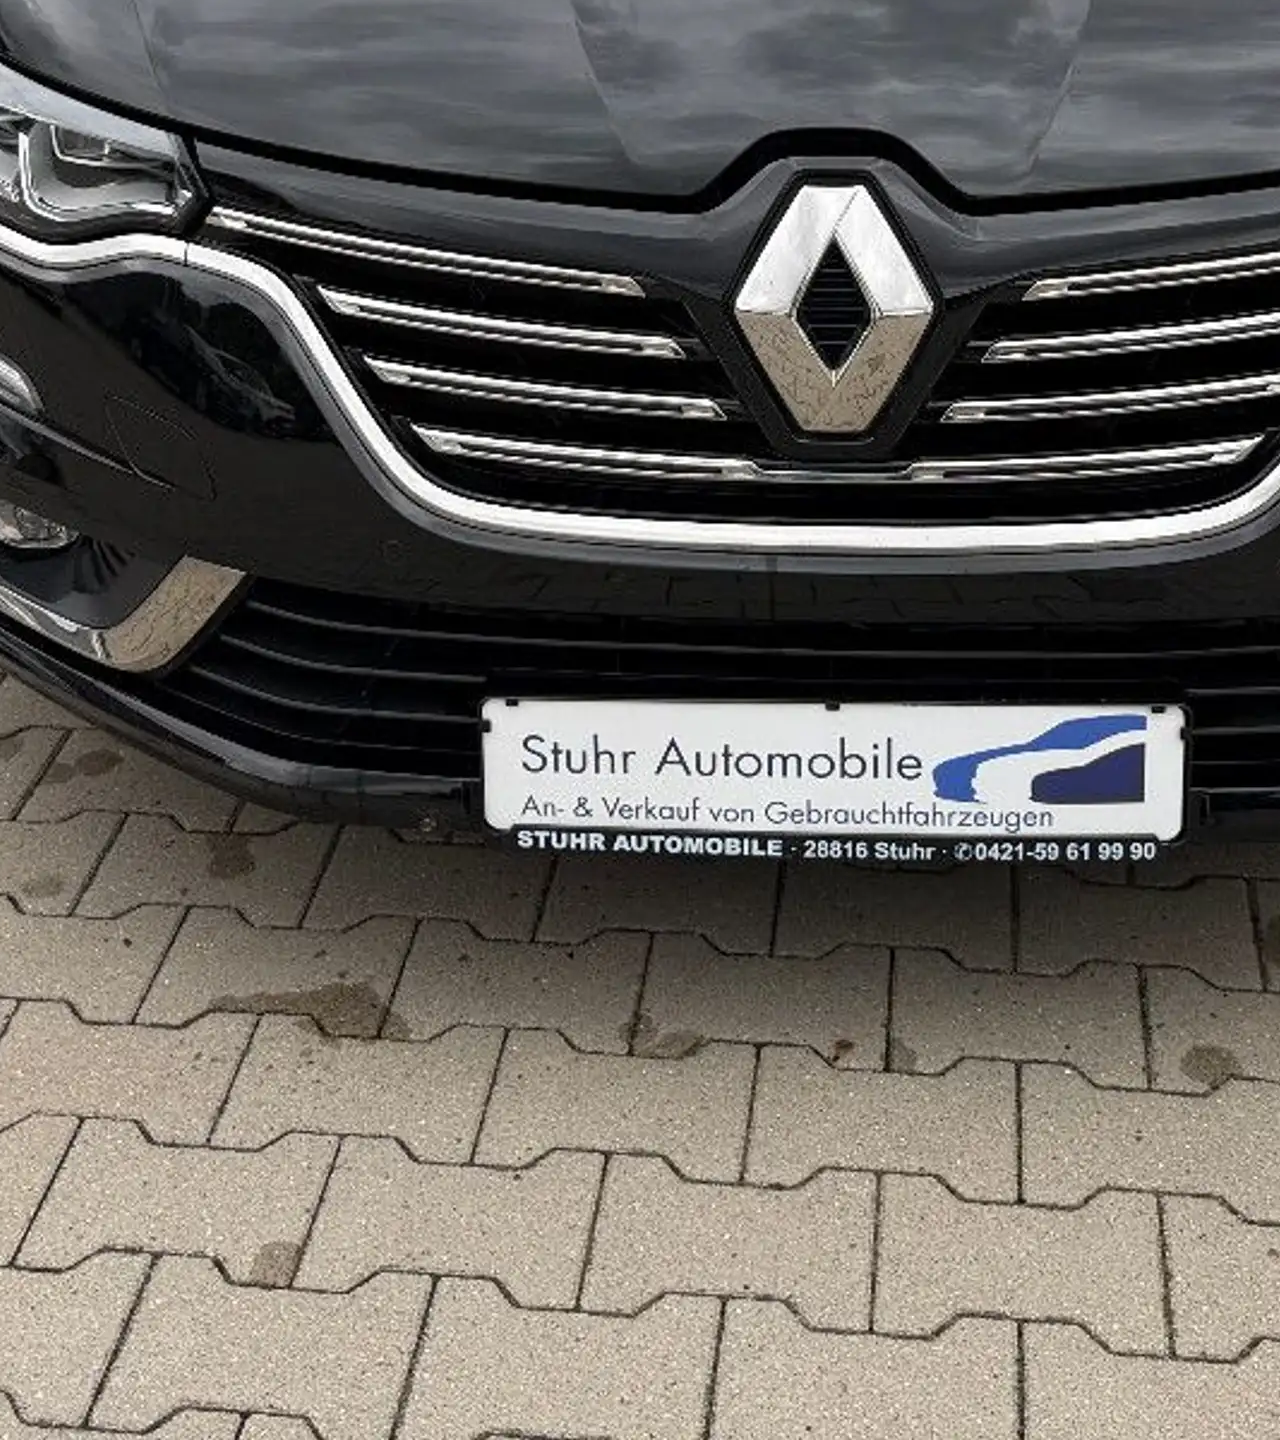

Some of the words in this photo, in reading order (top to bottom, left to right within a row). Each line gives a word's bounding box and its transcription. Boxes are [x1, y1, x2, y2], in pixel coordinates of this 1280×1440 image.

[521, 733, 637, 775] Stuhr
[655, 735, 923, 780] Automobile
[521, 794, 565, 817] An-
[572, 797, 594, 818] &
[602, 796, 700, 823] Verkauf
[709, 807, 755, 823] von
[764, 799, 1055, 833] Gebrauchtfahrzeugen
[516, 829, 607, 852] STUHR
[612, 833, 784, 858] AUTOMOBILE
[802, 839, 868, 860] 28816
[873, 840, 937, 862] Stuhr
[1066, 841, 1092, 862] 61
[1097, 841, 1125, 862] 99
[1129, 841, 1157, 861] 90
